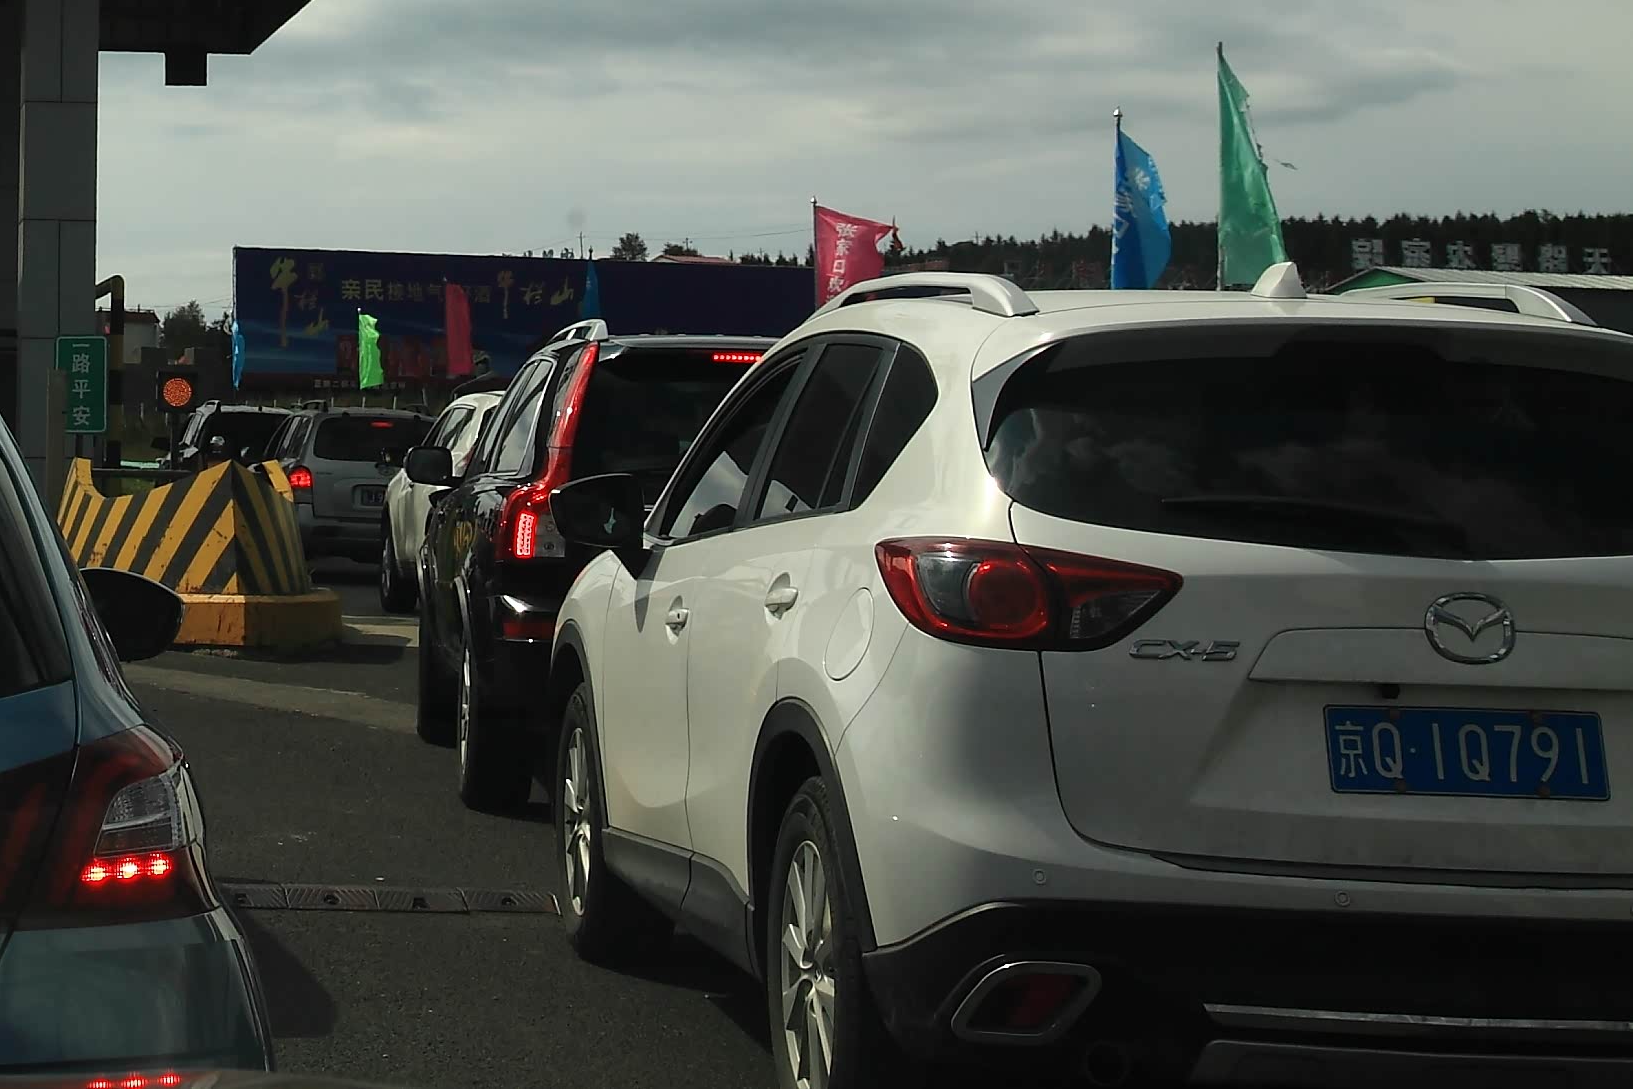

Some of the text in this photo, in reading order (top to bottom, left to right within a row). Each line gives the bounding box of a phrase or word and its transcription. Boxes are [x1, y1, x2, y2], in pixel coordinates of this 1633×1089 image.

[72, 343, 91, 426] 一路平安
[1129, 639, 1240, 662] CX-5
